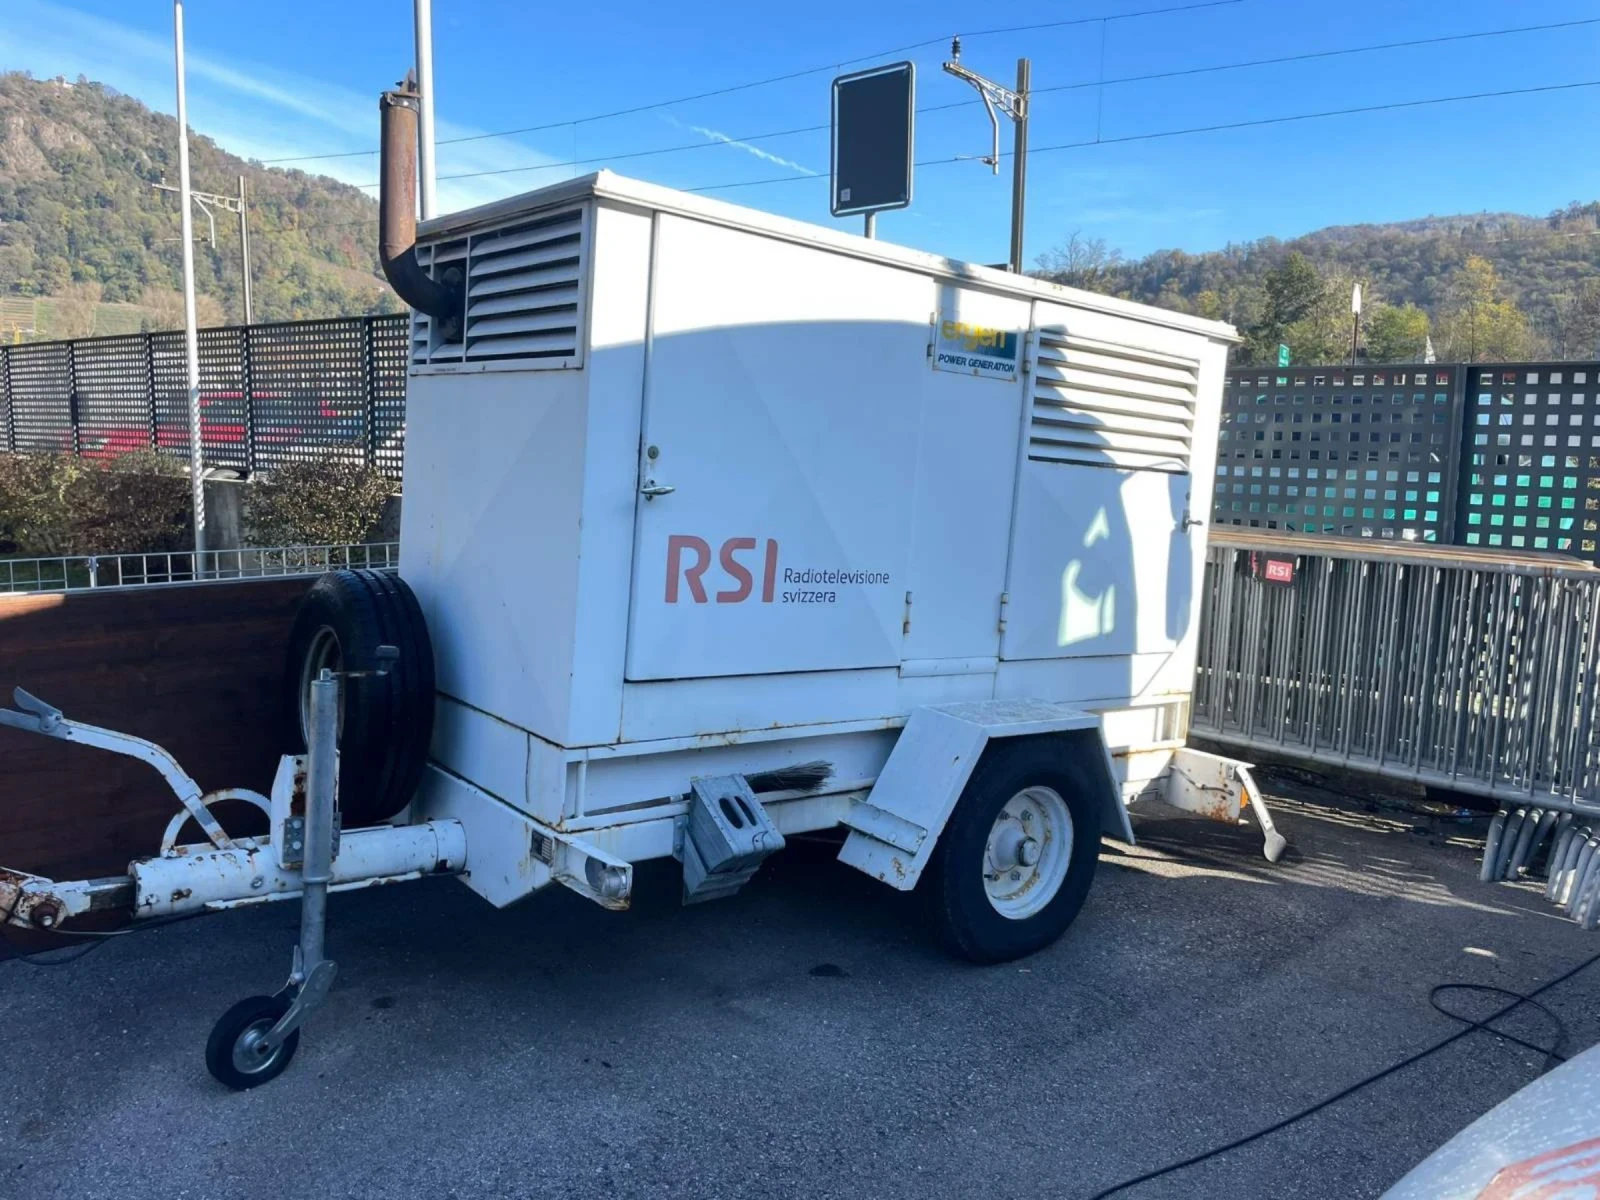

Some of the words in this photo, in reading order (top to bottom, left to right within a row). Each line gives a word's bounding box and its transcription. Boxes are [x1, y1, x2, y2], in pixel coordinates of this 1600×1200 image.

[938, 353, 967, 367] POWER
[968, 358, 1015, 373] GENERATION
[664, 534, 778, 604] RSI
[783, 567, 890, 585] Radiotelevisione
[1269, 564, 1291, 577] RSI
[782, 588, 836, 603] svizzera
